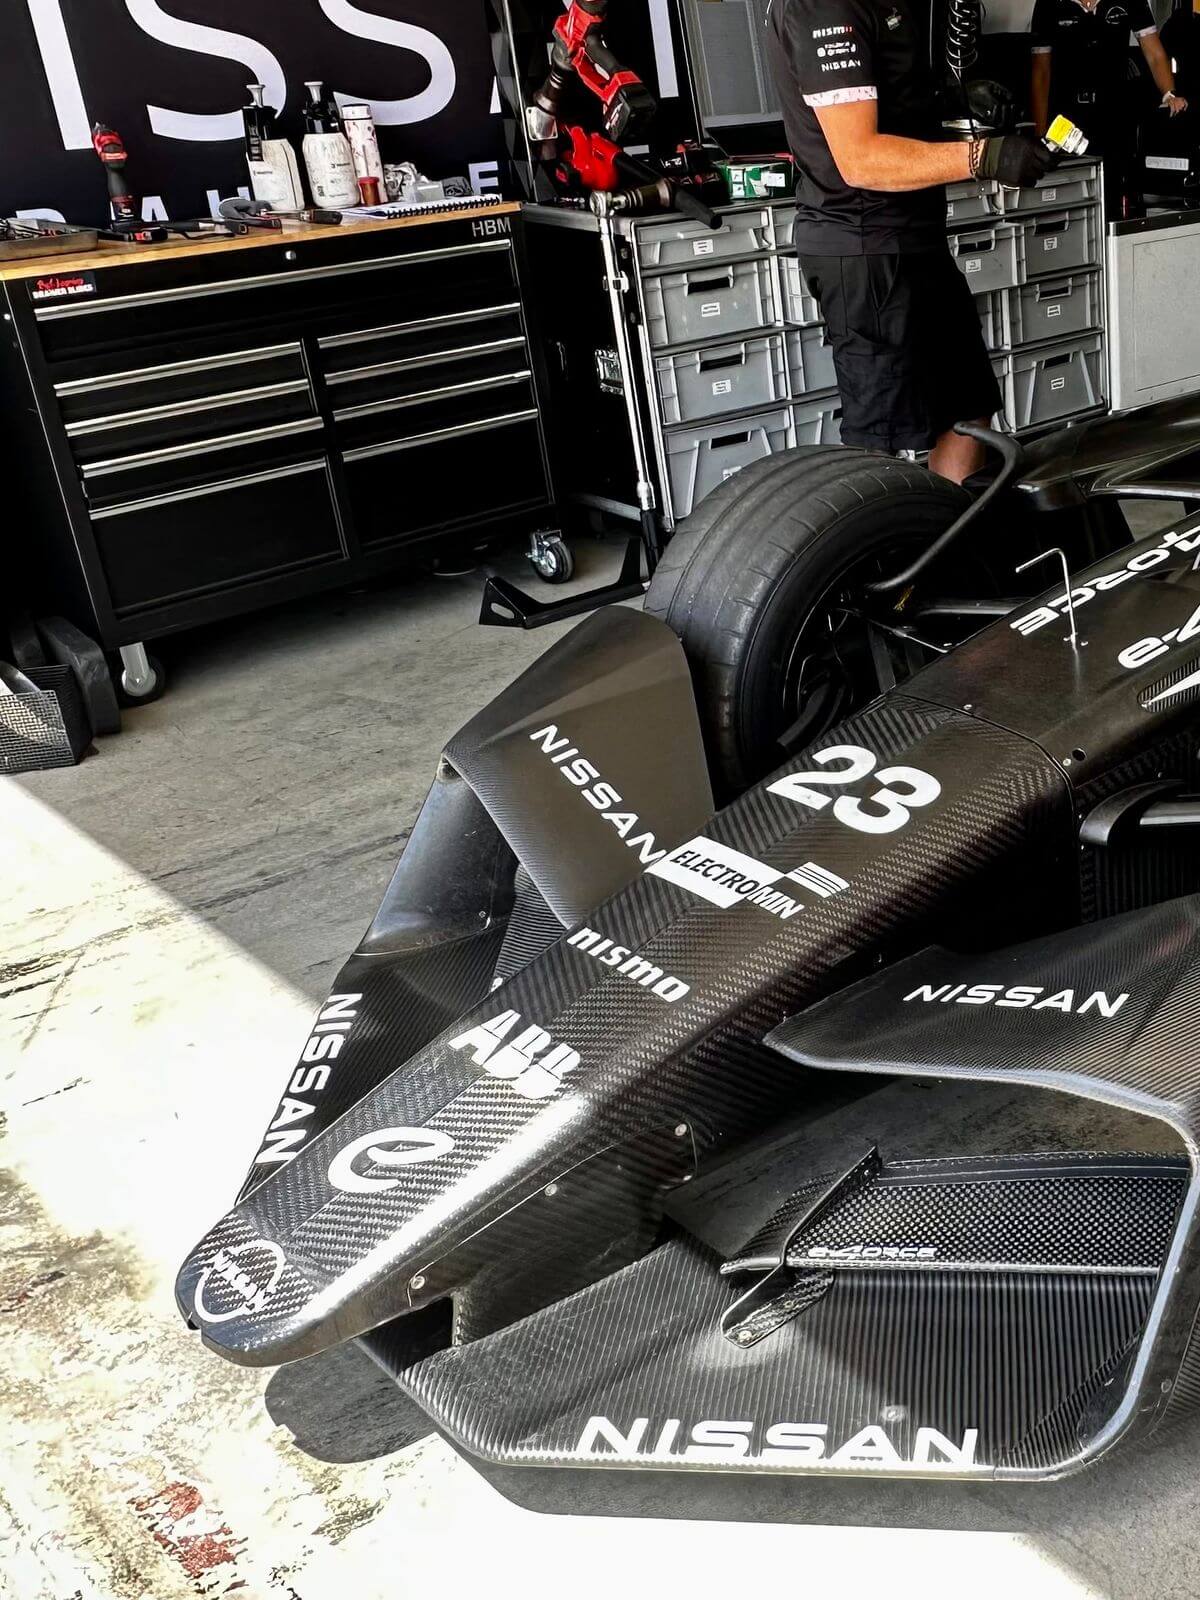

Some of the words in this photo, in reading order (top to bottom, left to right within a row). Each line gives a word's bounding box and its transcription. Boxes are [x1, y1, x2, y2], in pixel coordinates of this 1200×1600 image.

[821, 59, 861, 72] NISSAN
[471, 216, 512, 237] HBM
[529, 723, 668, 865] NISSAN
[766, 744, 942, 835] 23
[566, 925, 691, 1003] nismo
[902, 984, 1131, 1018] NISSAN
[256, 991, 363, 1165] NISSAN
[447, 1008, 582, 1100] ABB
[575, 1415, 979, 1467] NISSAN
